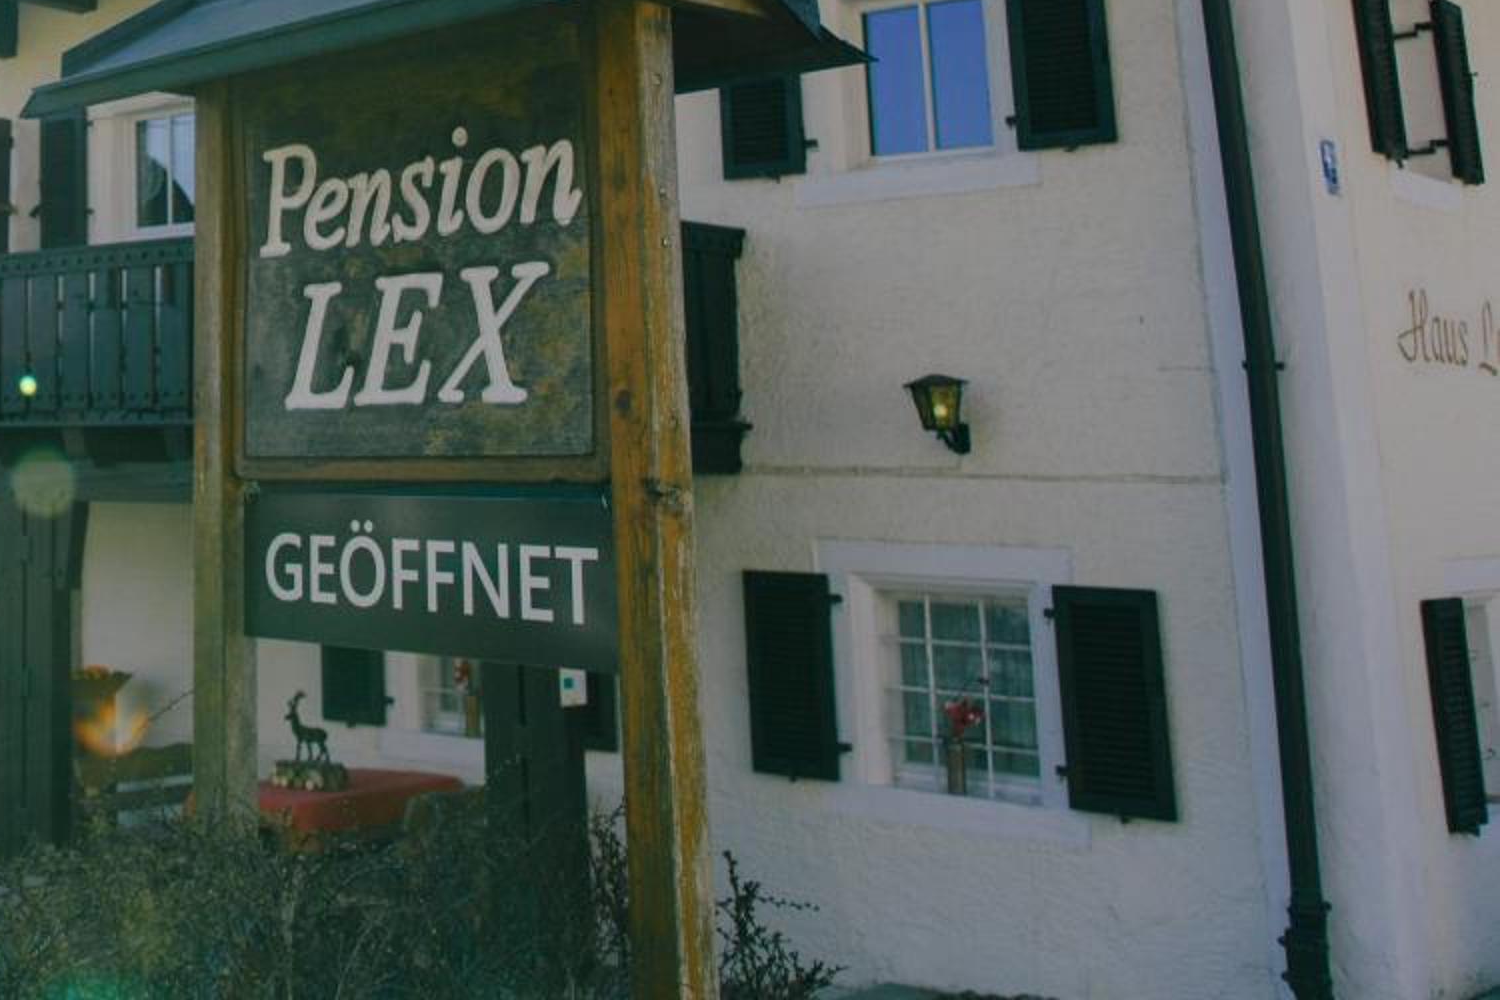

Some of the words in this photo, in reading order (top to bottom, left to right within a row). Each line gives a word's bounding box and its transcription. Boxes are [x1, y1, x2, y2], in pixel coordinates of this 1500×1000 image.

[260, 127, 581, 258] Pension
[284, 262, 550, 411] LEX
[1397, 288, 1469, 366] Haus
[1479, 300, 1500, 376] L
[265, 520, 599, 625] GEÖFFNET
